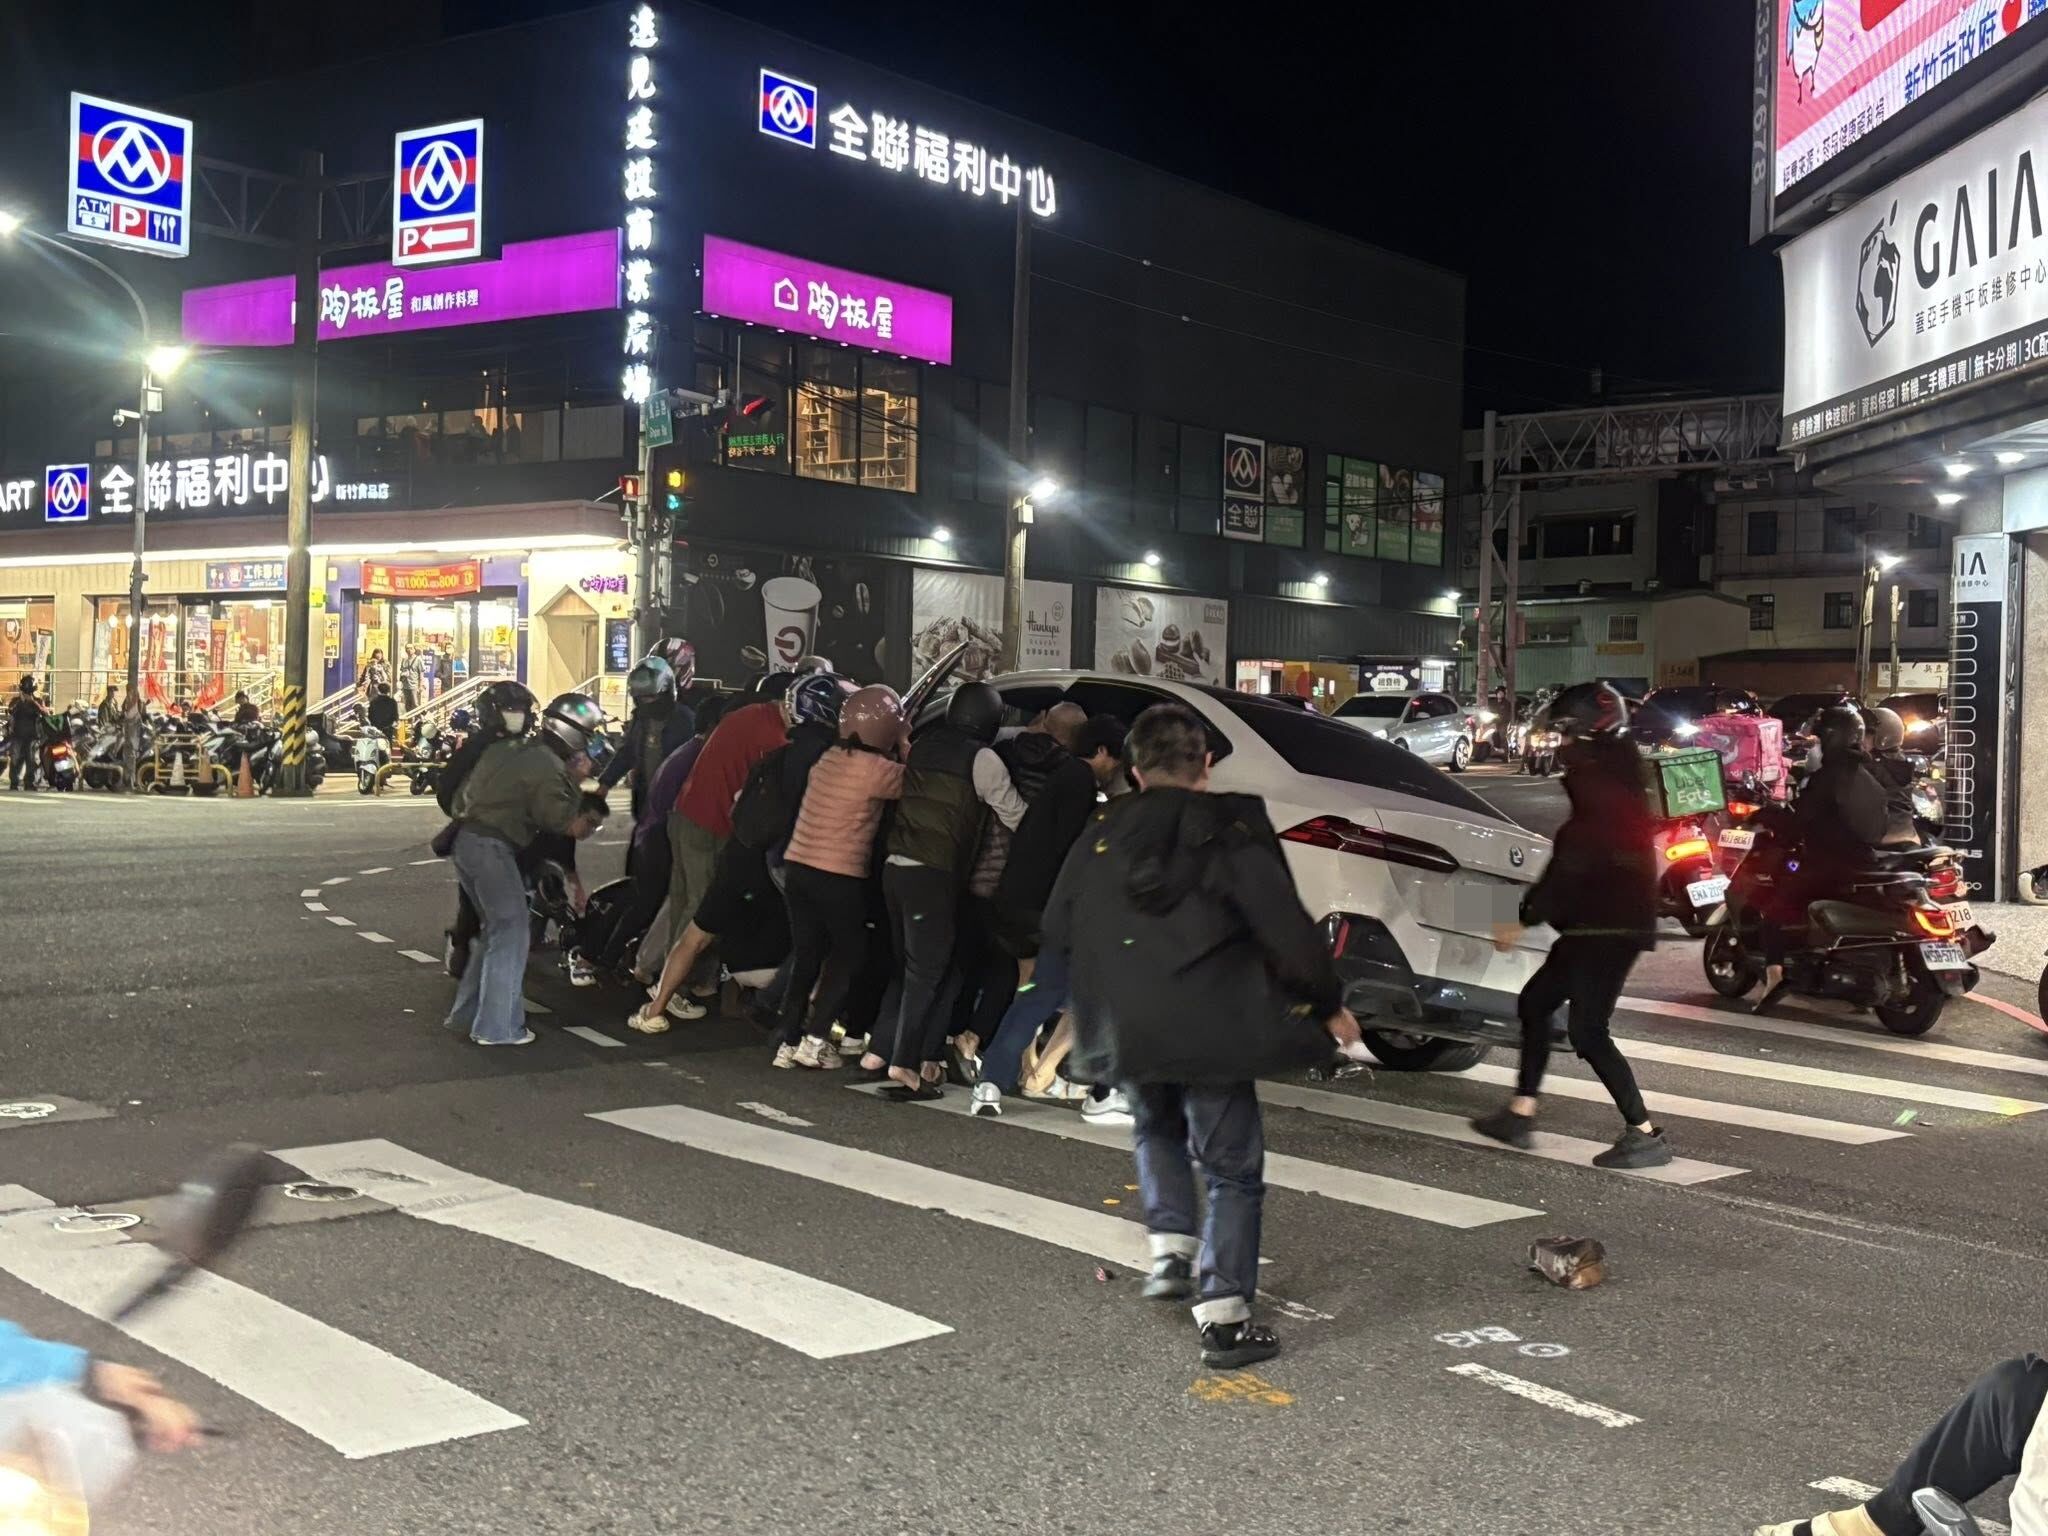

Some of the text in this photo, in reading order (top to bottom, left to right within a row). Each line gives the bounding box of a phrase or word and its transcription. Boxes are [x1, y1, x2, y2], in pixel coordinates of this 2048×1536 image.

[1904, 9, 1997, 104] 新竹市政府
[1754, 0, 1770, 186] 33-7678
[829, 103, 1057, 218] 全聯福利中心
[78, 198, 110, 214] ATM
[119, 205, 142, 233] P
[1914, 150, 2043, 290] GAIA
[402, 229, 419, 255] P
[320, 277, 479, 329] 陶板屋 和風創作料理
[807, 281, 893, 338] 陶板屋
[1915, 259, 2047, 335] 蓋亞手機平板維修中心
[1974, 342, 2017, 379] 無卡分期
[335, 483, 390, 500] 新竹食品店
